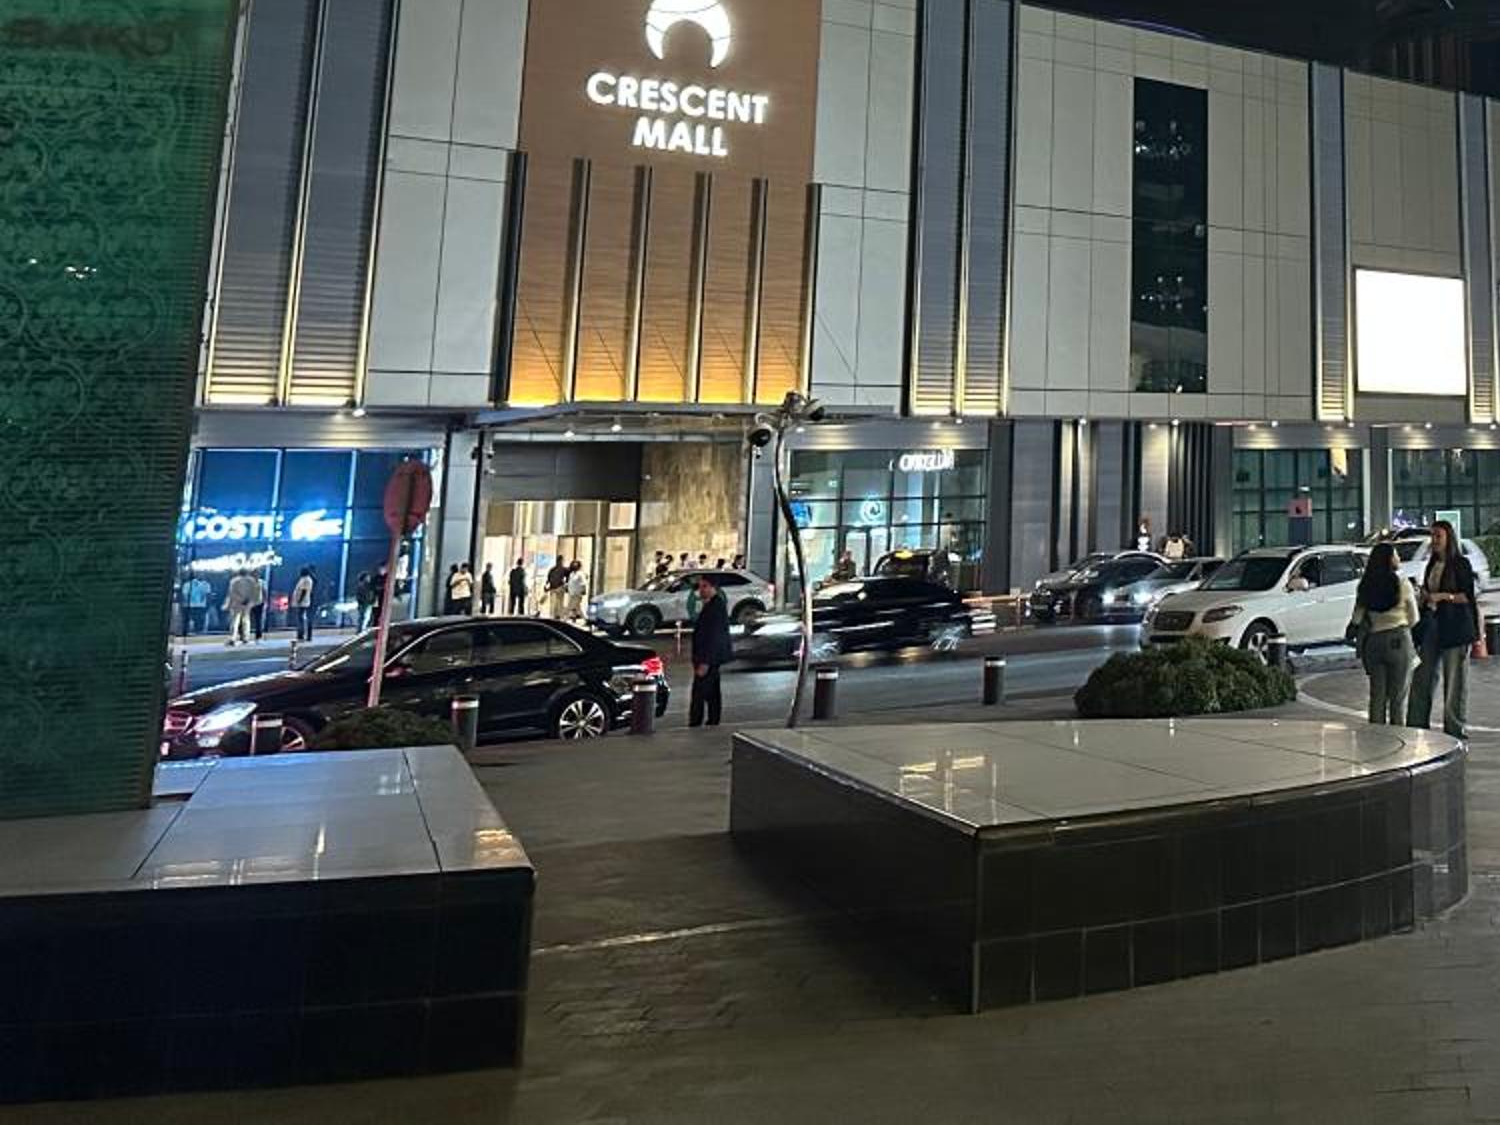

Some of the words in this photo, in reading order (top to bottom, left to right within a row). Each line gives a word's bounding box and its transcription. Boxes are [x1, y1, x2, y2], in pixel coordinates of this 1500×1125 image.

[586, 72, 769, 124] CRESCENT
[633, 117, 728, 156] MALL
[184, 514, 285, 540] COSTE
